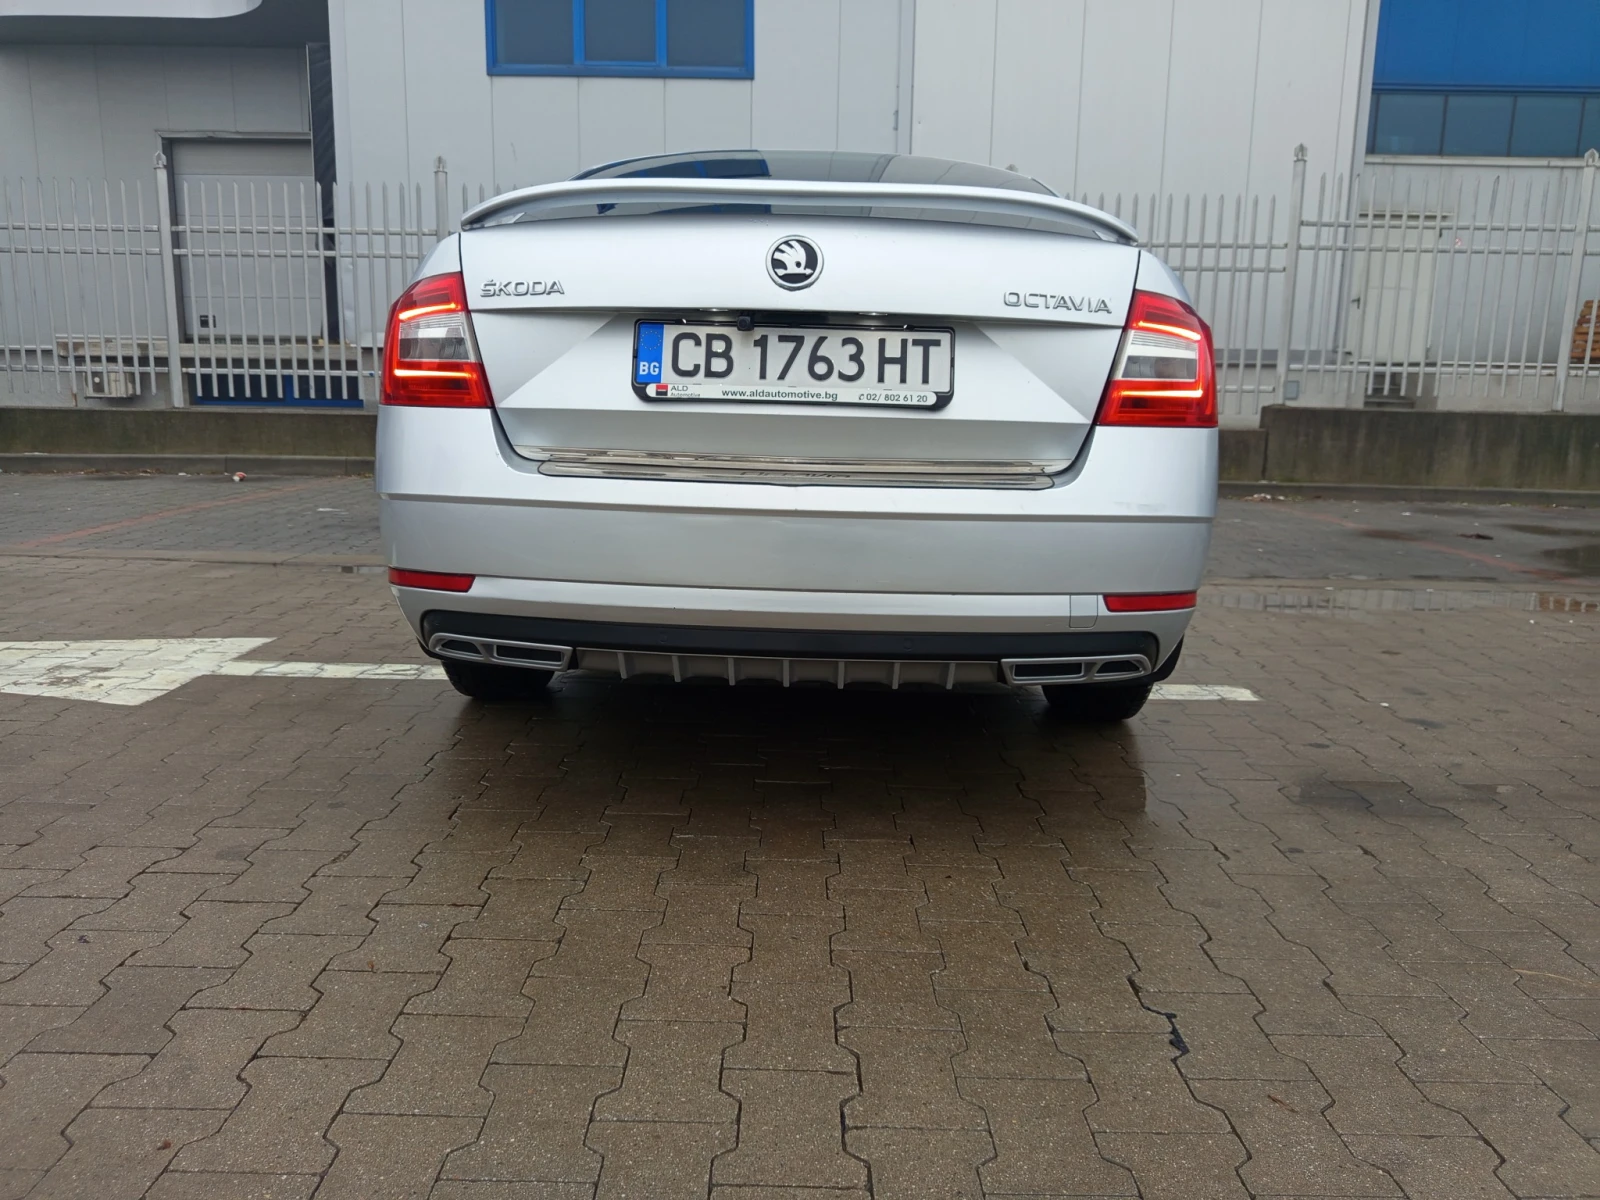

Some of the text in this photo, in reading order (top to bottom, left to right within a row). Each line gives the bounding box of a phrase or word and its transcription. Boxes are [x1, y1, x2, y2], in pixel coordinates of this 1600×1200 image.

[480, 279, 565, 297] ŠKODA
[1003, 291, 1112, 314] OCTAVIA
[671, 332, 942, 384] CB 1763 HT
[639, 361, 660, 375] BG
[721, 388, 838, 401] www.aldautomotive.bg
[884, 393, 901, 402] 802
[904, 394, 914, 402] 61
[916, 394, 928, 403] 20
